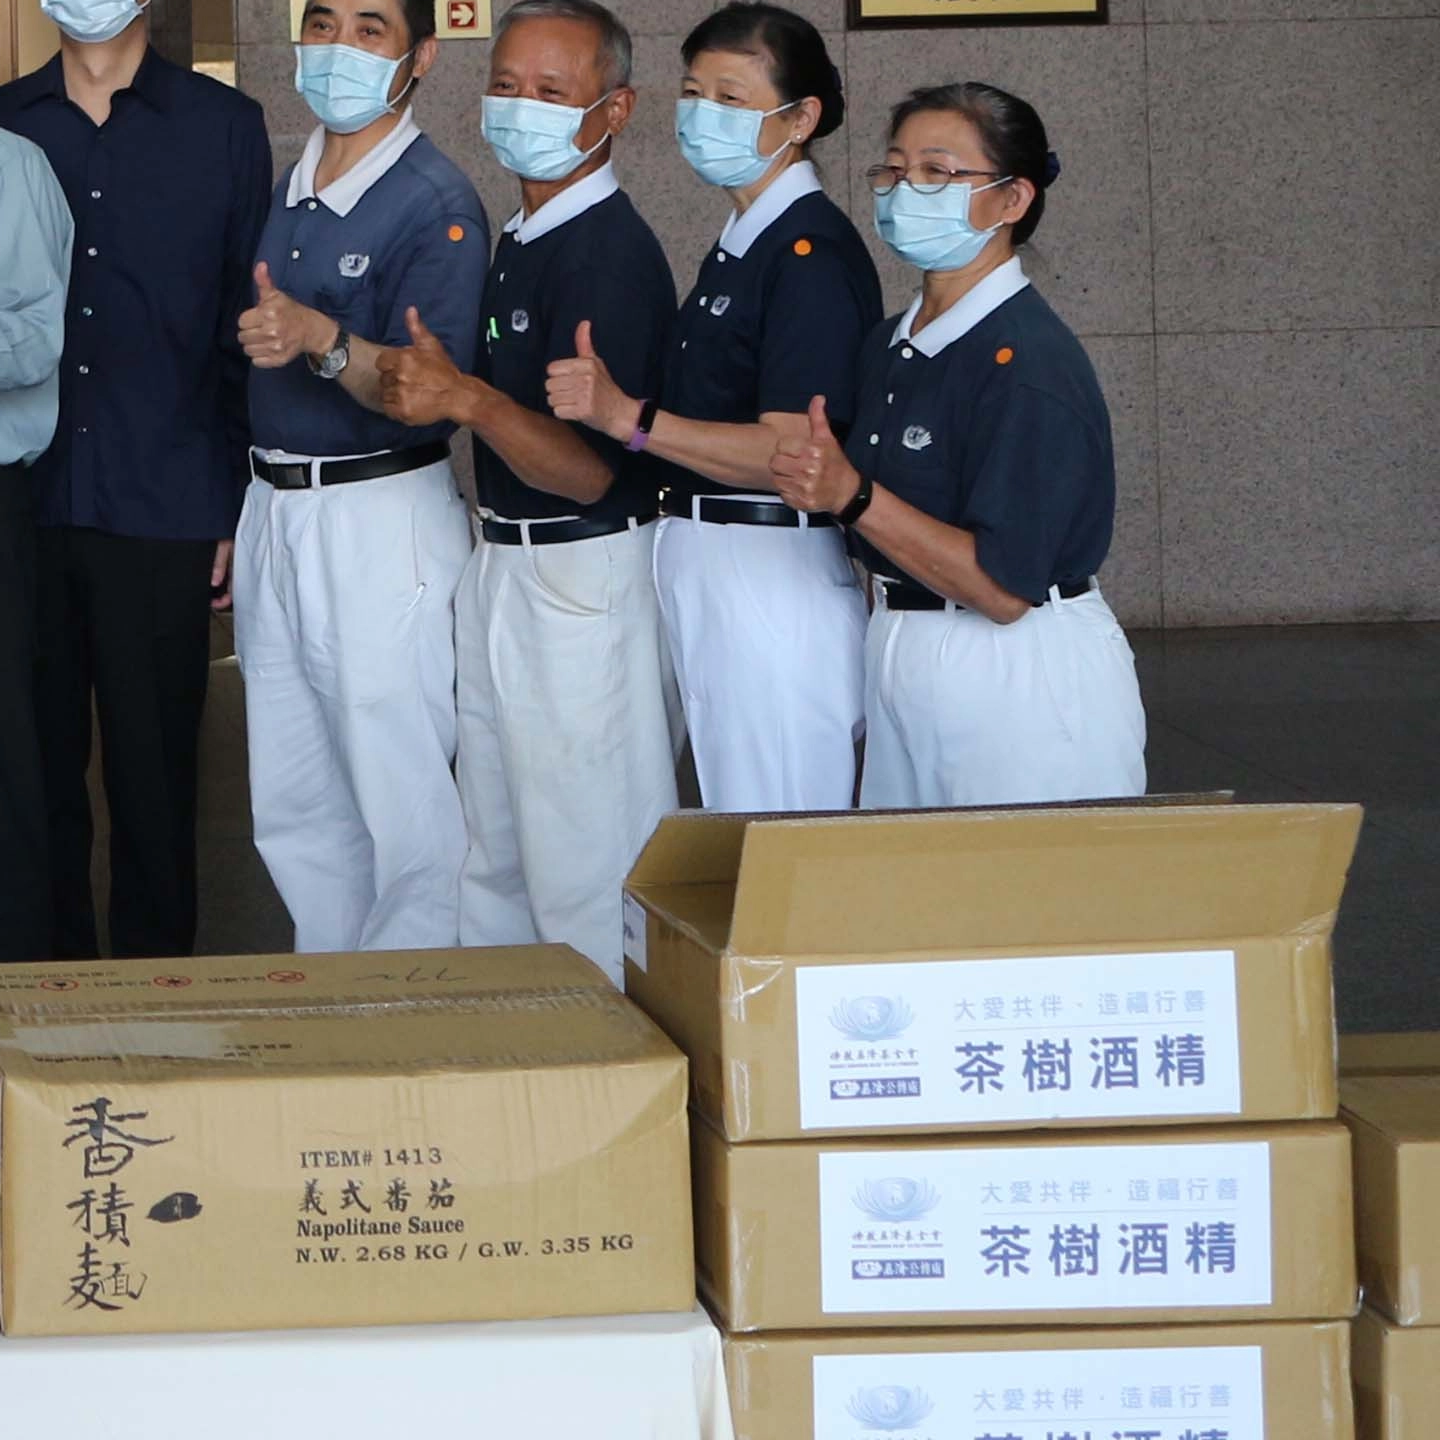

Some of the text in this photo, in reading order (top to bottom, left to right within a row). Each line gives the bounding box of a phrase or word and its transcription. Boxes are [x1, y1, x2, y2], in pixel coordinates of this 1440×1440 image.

[954, 1033, 1207, 1095] 茶樹酒精
[301, 1148, 441, 1168] ITEM# 1413
[63, 1096, 175, 1311] 香積麵
[300, 1178, 454, 1218] 義式番茄
[298, 1213, 463, 1241] Napolitane Sauce
[297, 1235, 632, 1263] N.W. 2.68 KG / G.W. 3.35 KG
[979, 1220, 1238, 1279] 茶樹酒精
